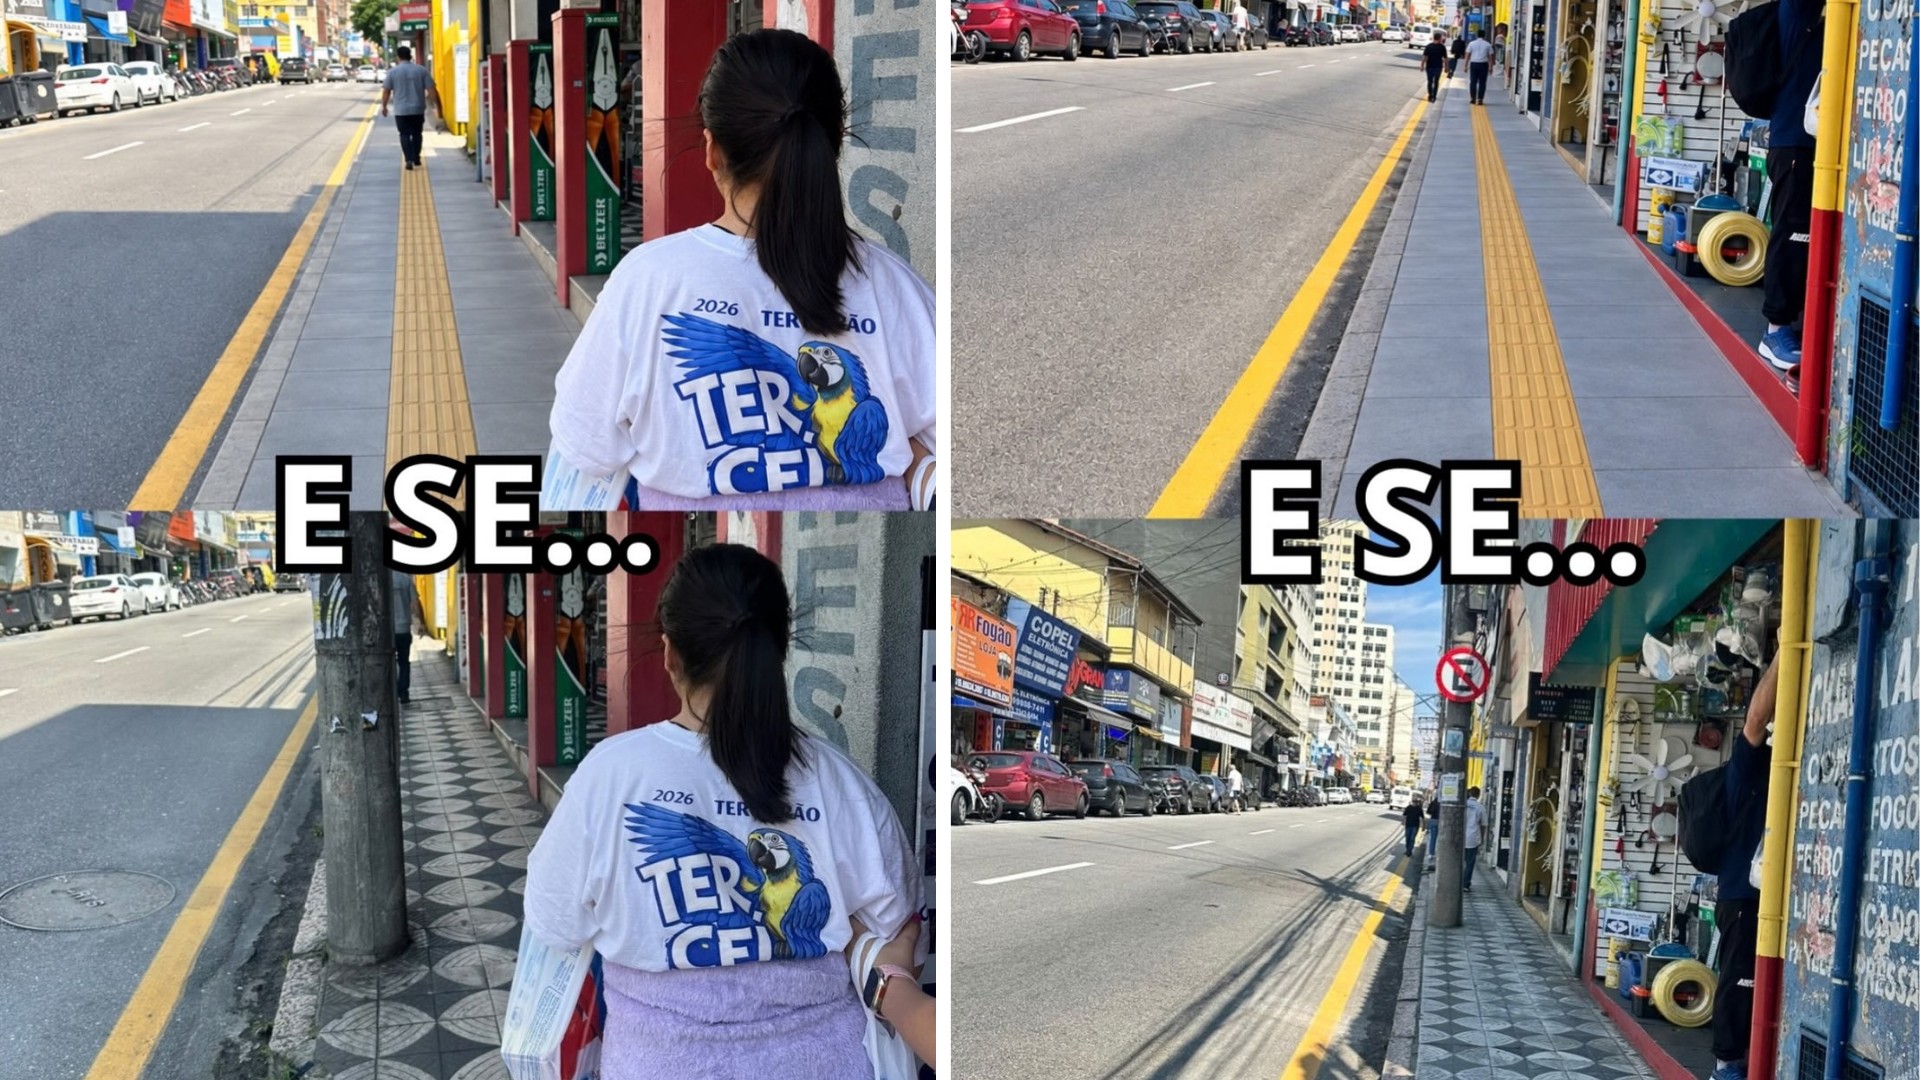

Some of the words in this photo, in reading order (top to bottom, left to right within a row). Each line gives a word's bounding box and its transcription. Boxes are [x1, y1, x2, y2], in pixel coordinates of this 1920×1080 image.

[595, 198, 606, 250] BELZER
[692, 298, 739, 316] 2026
[979, 640, 997, 655] LOJA
[1030, 615, 1075, 651] COPEL
[564, 697, 573, 745] BELZER
[652, 789, 694, 805] 2026
[1796, 843, 1844, 878] FERRO
